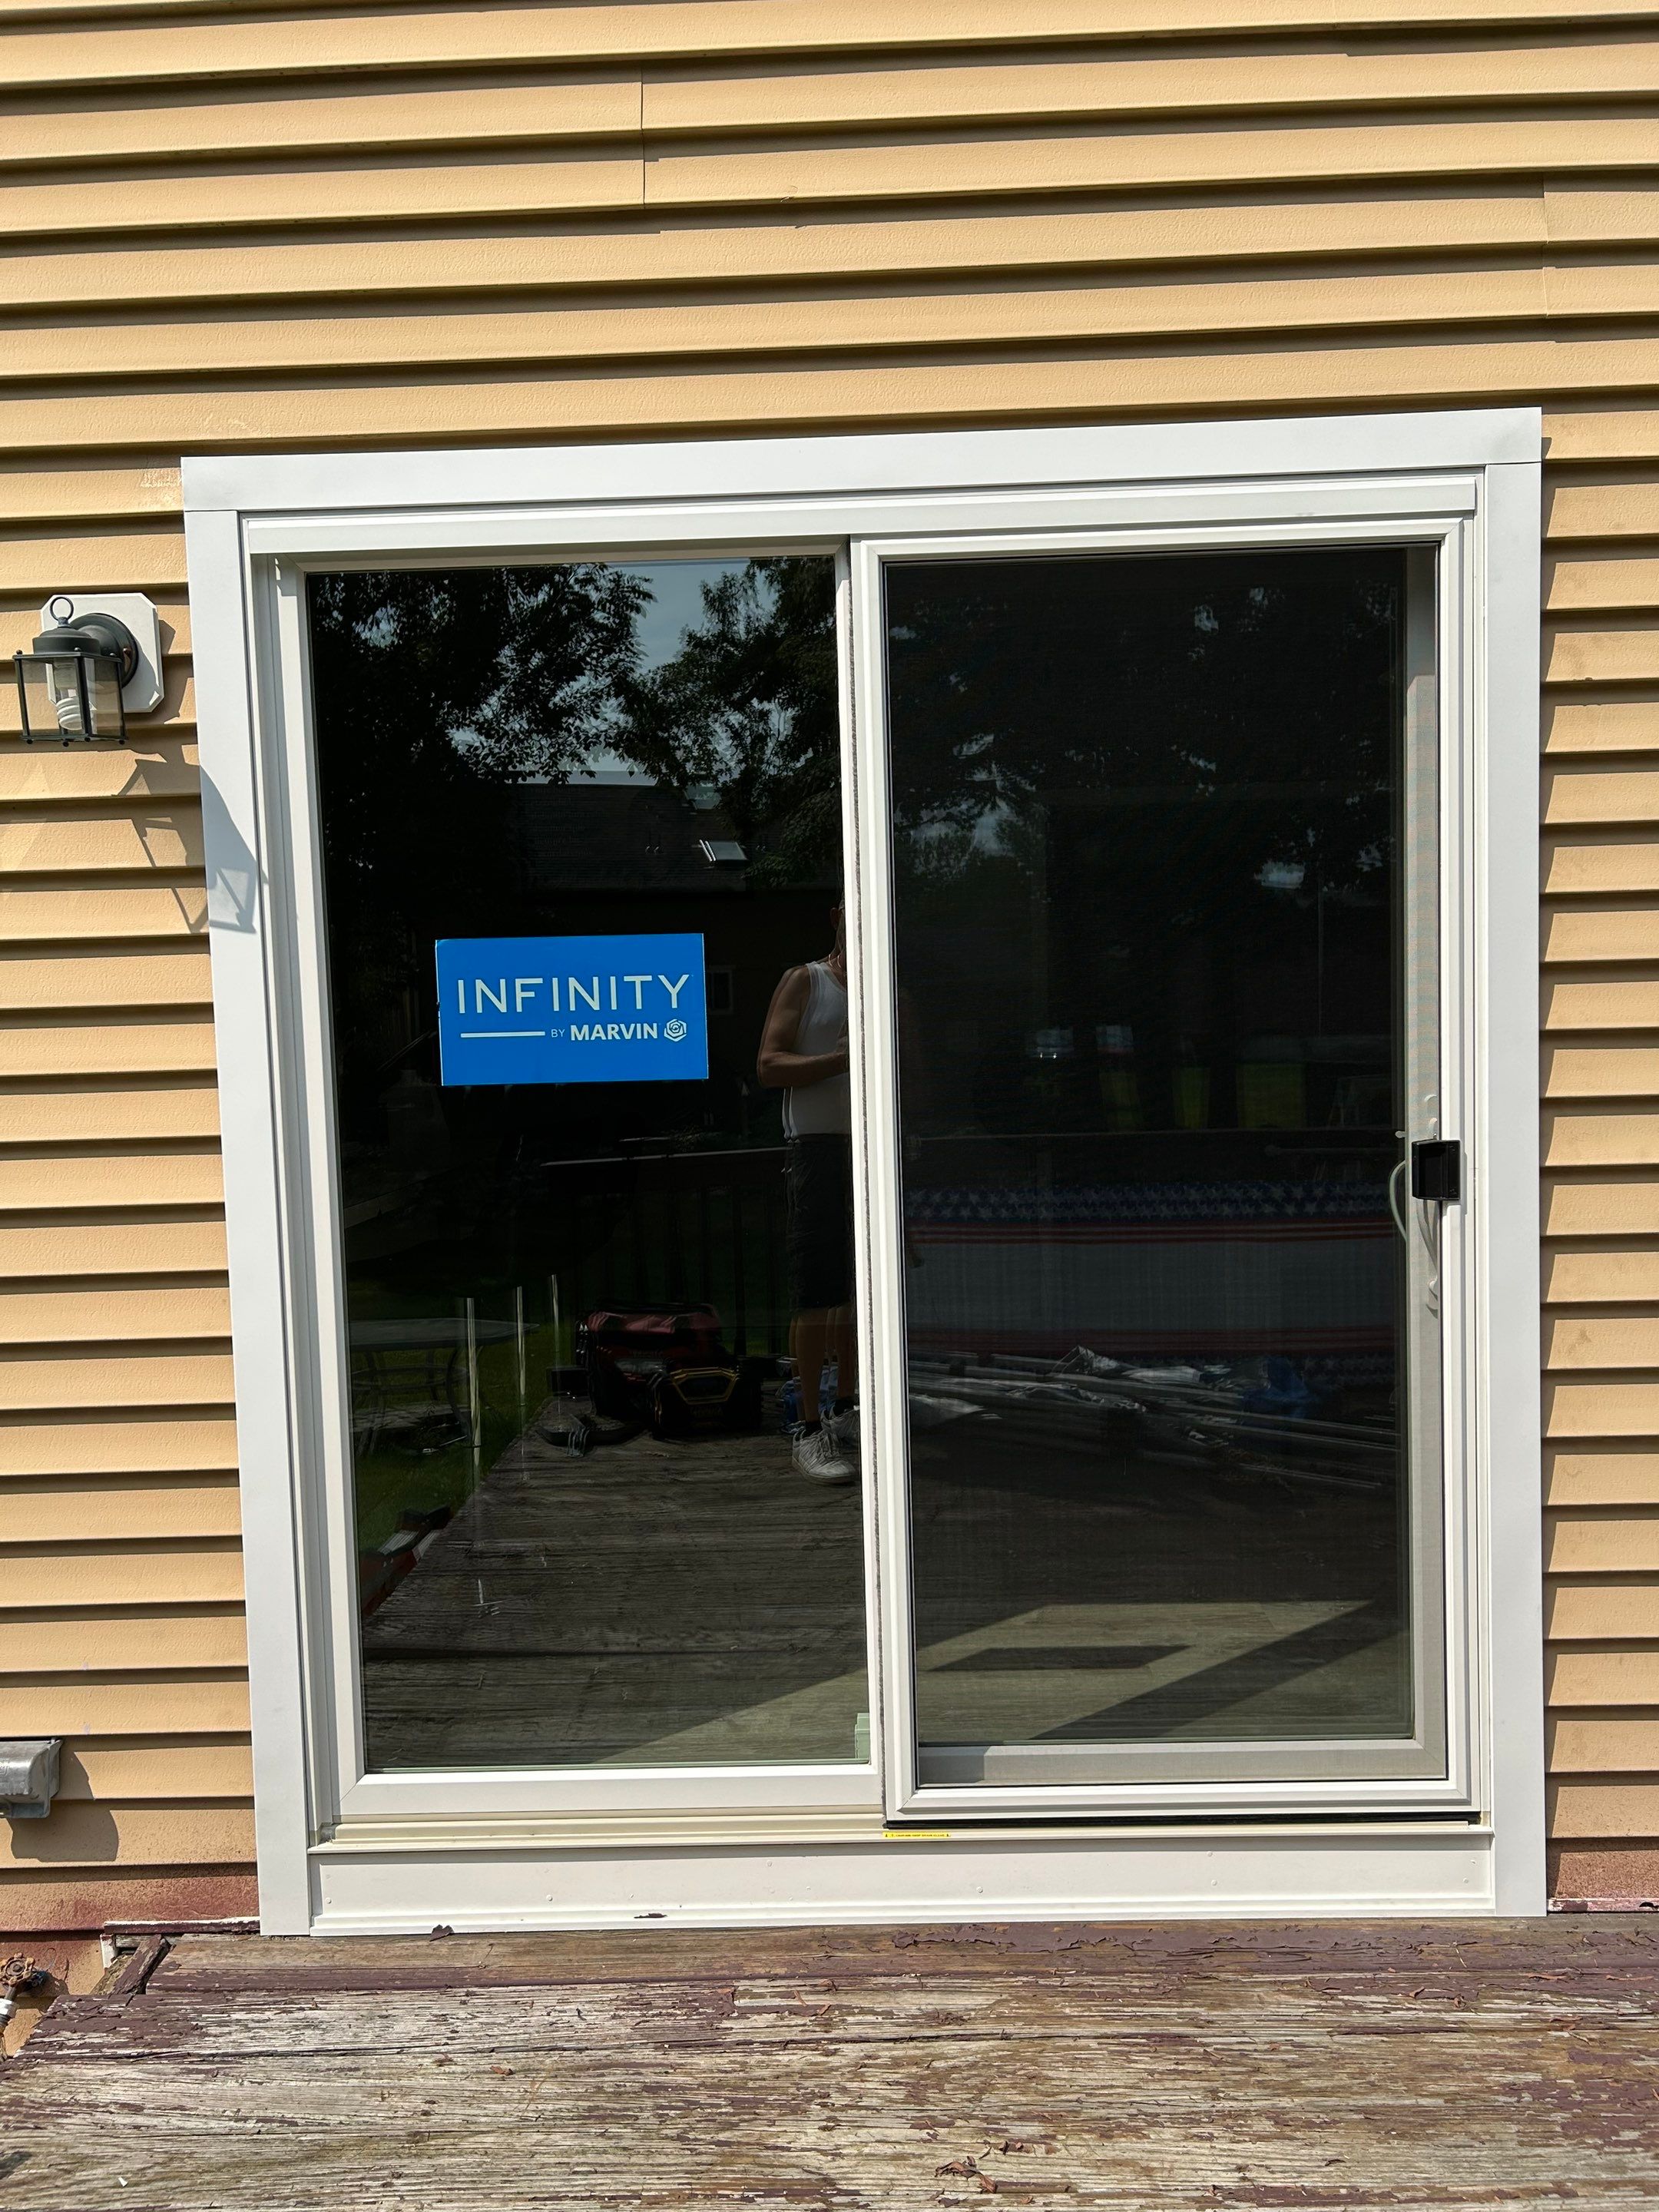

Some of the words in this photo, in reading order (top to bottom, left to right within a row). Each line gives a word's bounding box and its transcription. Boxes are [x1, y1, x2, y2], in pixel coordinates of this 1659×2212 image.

[458, 974, 690, 1014] INFINITY
[551, 1028, 565, 1038] BY
[571, 1022, 658, 1041] MARVIN
